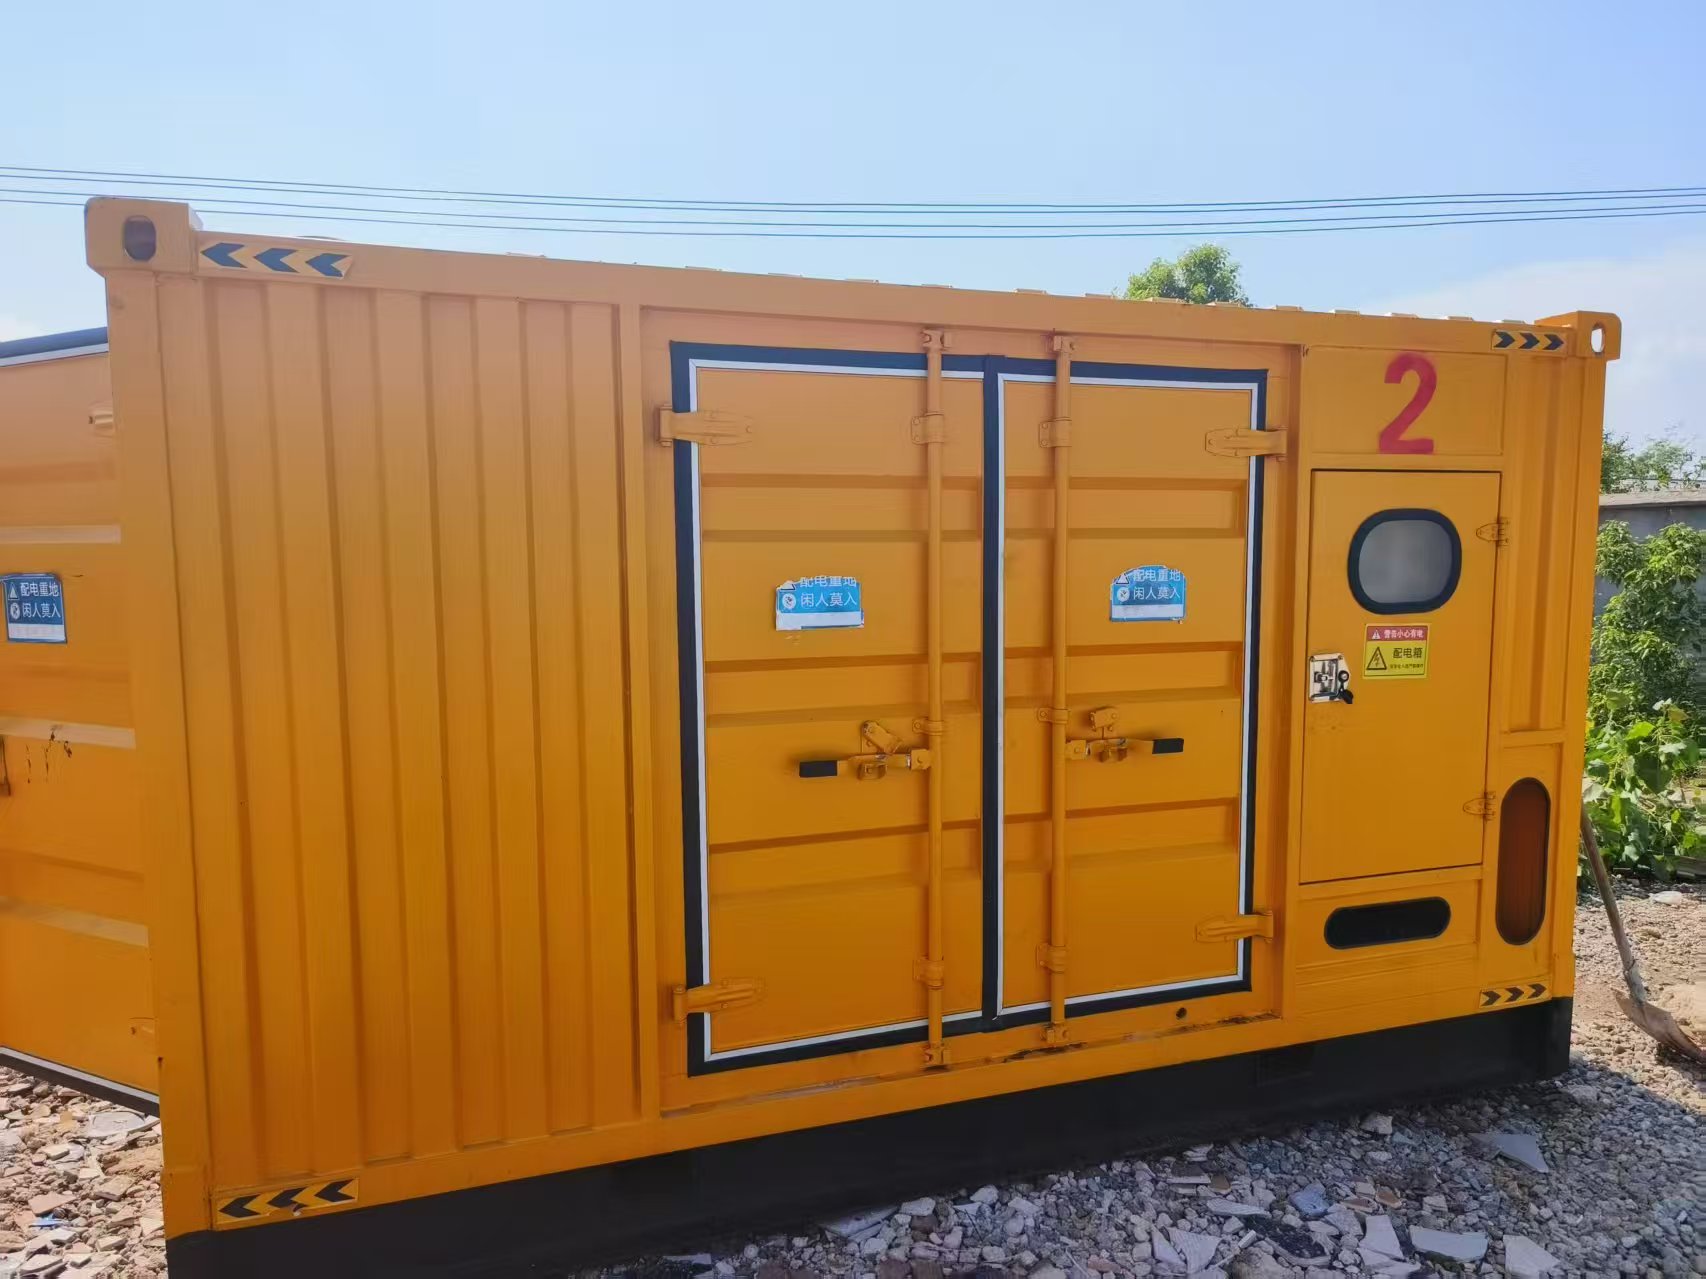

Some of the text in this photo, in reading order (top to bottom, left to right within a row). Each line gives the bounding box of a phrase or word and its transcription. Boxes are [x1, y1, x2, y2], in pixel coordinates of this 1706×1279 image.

[1379, 351, 1437, 455] 2
[20, 581, 59, 597] 配电重地
[1133, 586, 1181, 600] 闲人莫入
[801, 592, 857, 607] 闲人莫入
[22, 602, 61, 618] 闲人莫入
[1393, 647, 1423, 659] 配电箱
